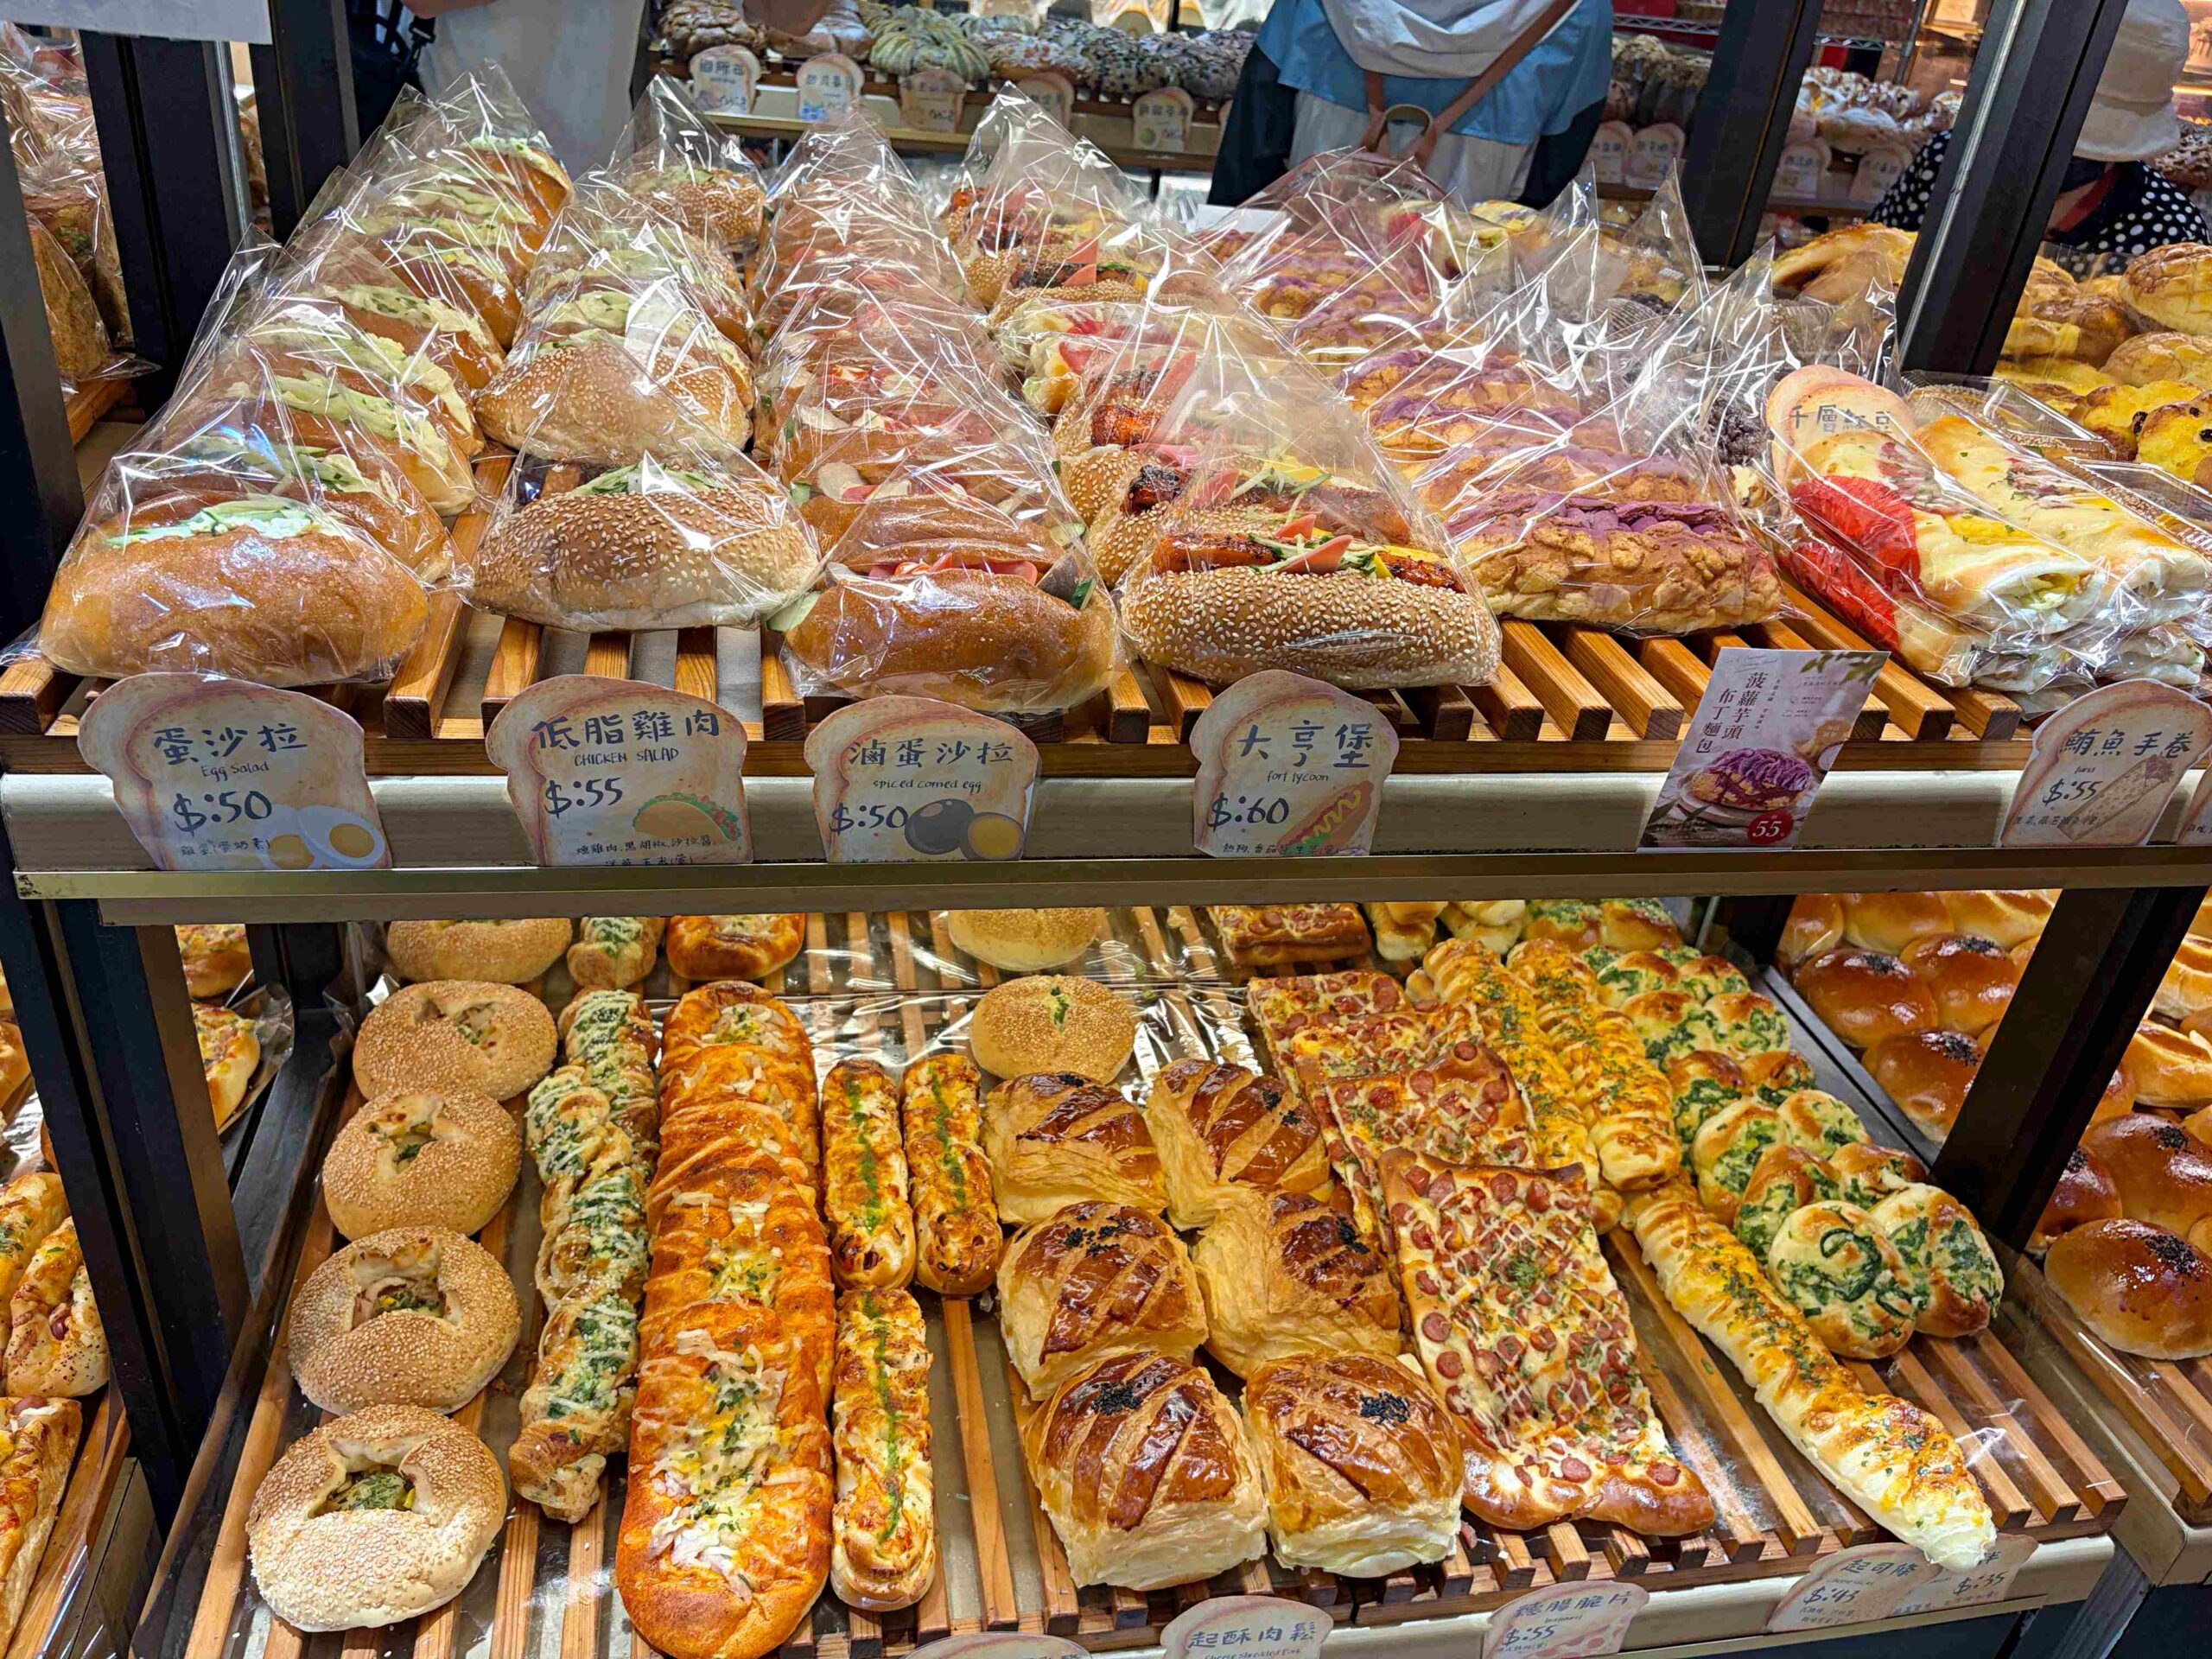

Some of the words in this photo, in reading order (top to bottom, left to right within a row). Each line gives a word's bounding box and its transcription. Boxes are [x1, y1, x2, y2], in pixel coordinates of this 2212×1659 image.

[1695, 688, 1738, 753] 布丁麵包
[1720, 671, 1769, 740] 菠蘿芋頭
[153, 723, 308, 766] 蛋沙拉
[531, 709, 719, 750] 低脂雞肉
[1237, 720, 1374, 768] 大亨堡
[2060, 728, 2194, 759] 鮪魚手卷
[575, 752, 627, 767] CHICKEN
[637, 747, 679, 763] SALAD
[847, 738, 1014, 768] 滷蛋沙拉
[200, 765, 228, 782] Egg
[231, 760, 270, 774] Salad
[873, 779, 913, 789] spiced
[963, 780, 982, 794] egg
[1752, 820, 1782, 837] 55
[1840, 1559, 1919, 1578] 起司條
[1188, 1620, 1317, 1649] 起酥肉鬆
